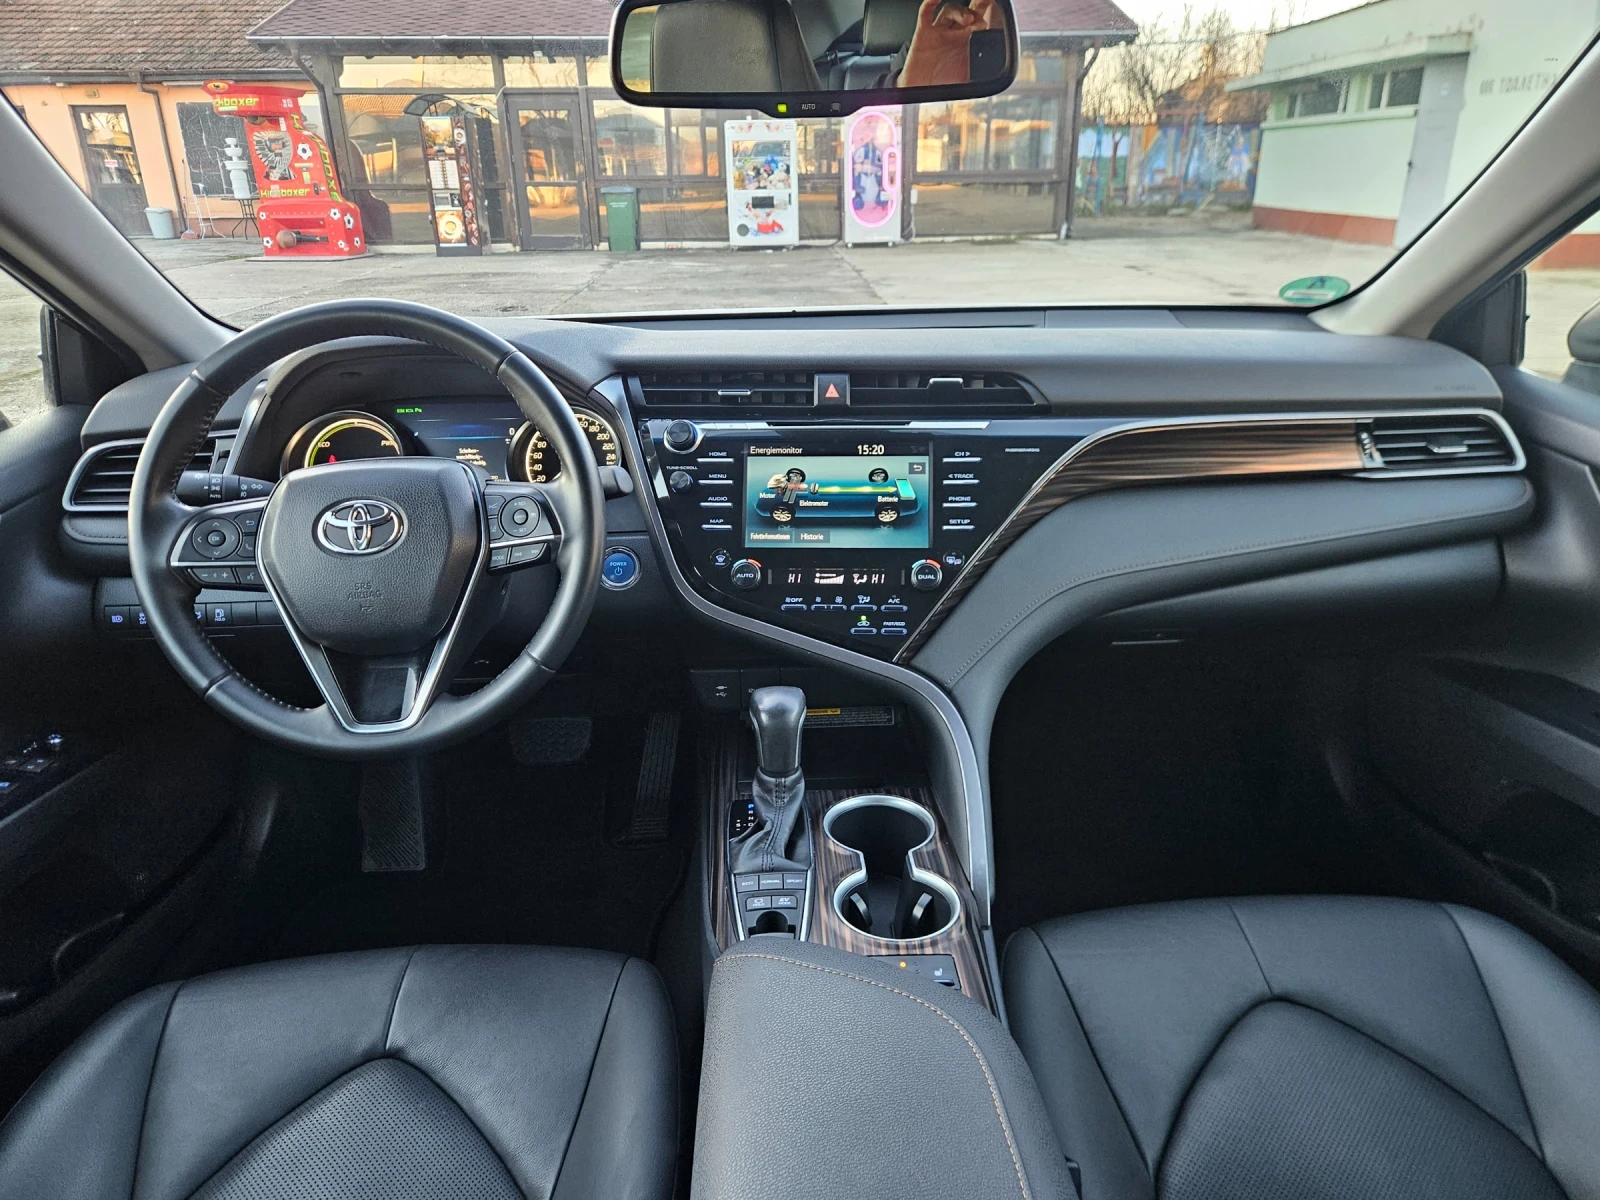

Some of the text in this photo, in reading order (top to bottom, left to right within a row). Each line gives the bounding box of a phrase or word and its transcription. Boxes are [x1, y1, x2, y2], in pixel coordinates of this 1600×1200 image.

[596, 432, 610, 440] 200
[750, 446, 802, 455] Energiemonitor
[857, 445, 885, 455] 15:20
